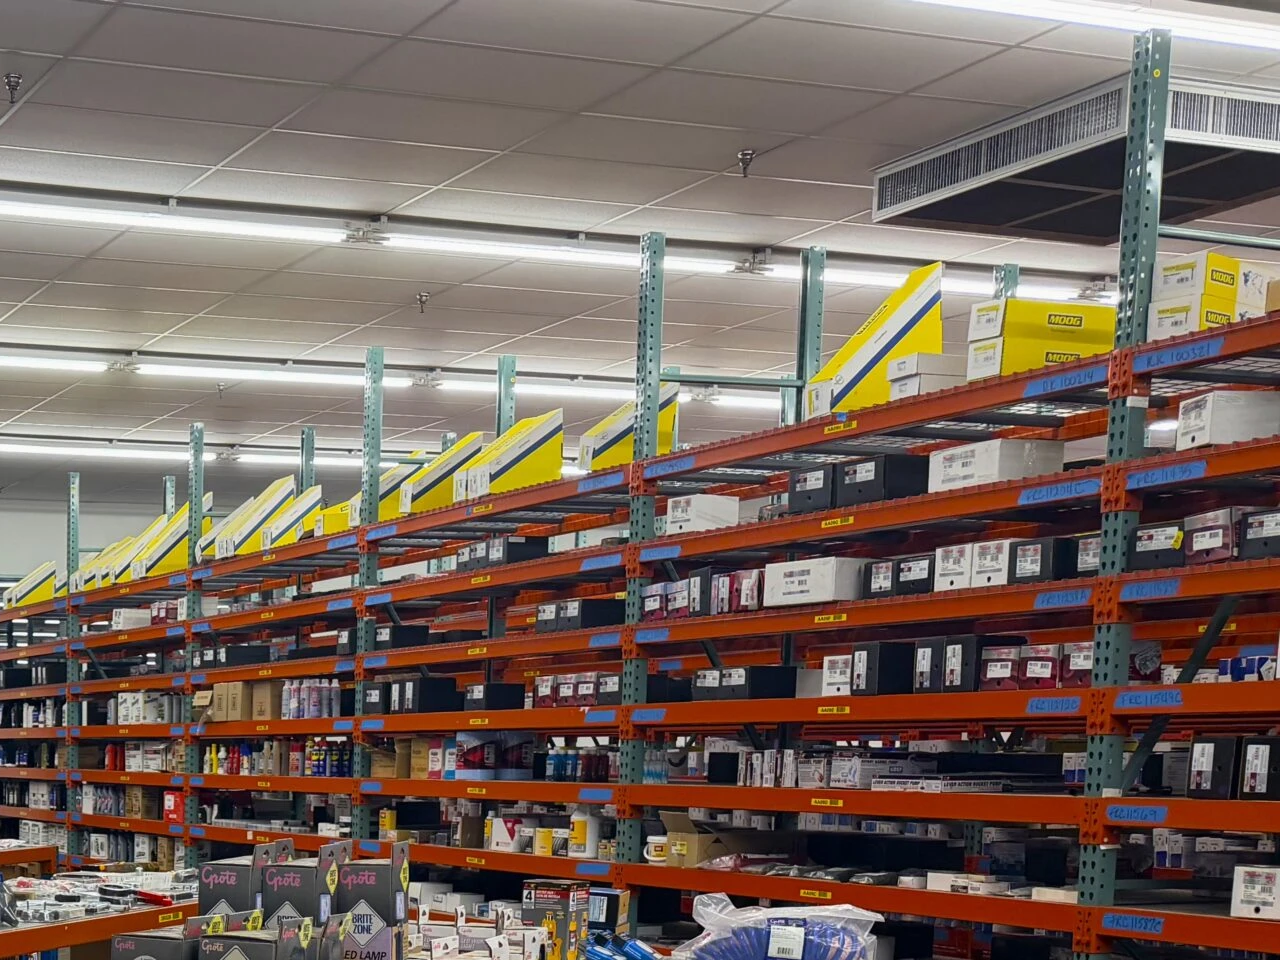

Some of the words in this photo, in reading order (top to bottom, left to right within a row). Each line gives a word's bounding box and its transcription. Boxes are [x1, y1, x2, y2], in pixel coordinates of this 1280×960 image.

[1212, 270, 1235, 286] MOOG
[1049, 314, 1082, 326] MOOG
[201, 867, 237, 889] Grote
[266, 868, 301, 892] Grote
[340, 867, 377, 890] Grote
[352, 914, 373, 924] BRITE
[353, 924, 373, 935] ZONE
[201, 940, 224, 954] Grote
[344, 951, 358, 959] ED
[360, 951, 387, 960] LAMP
